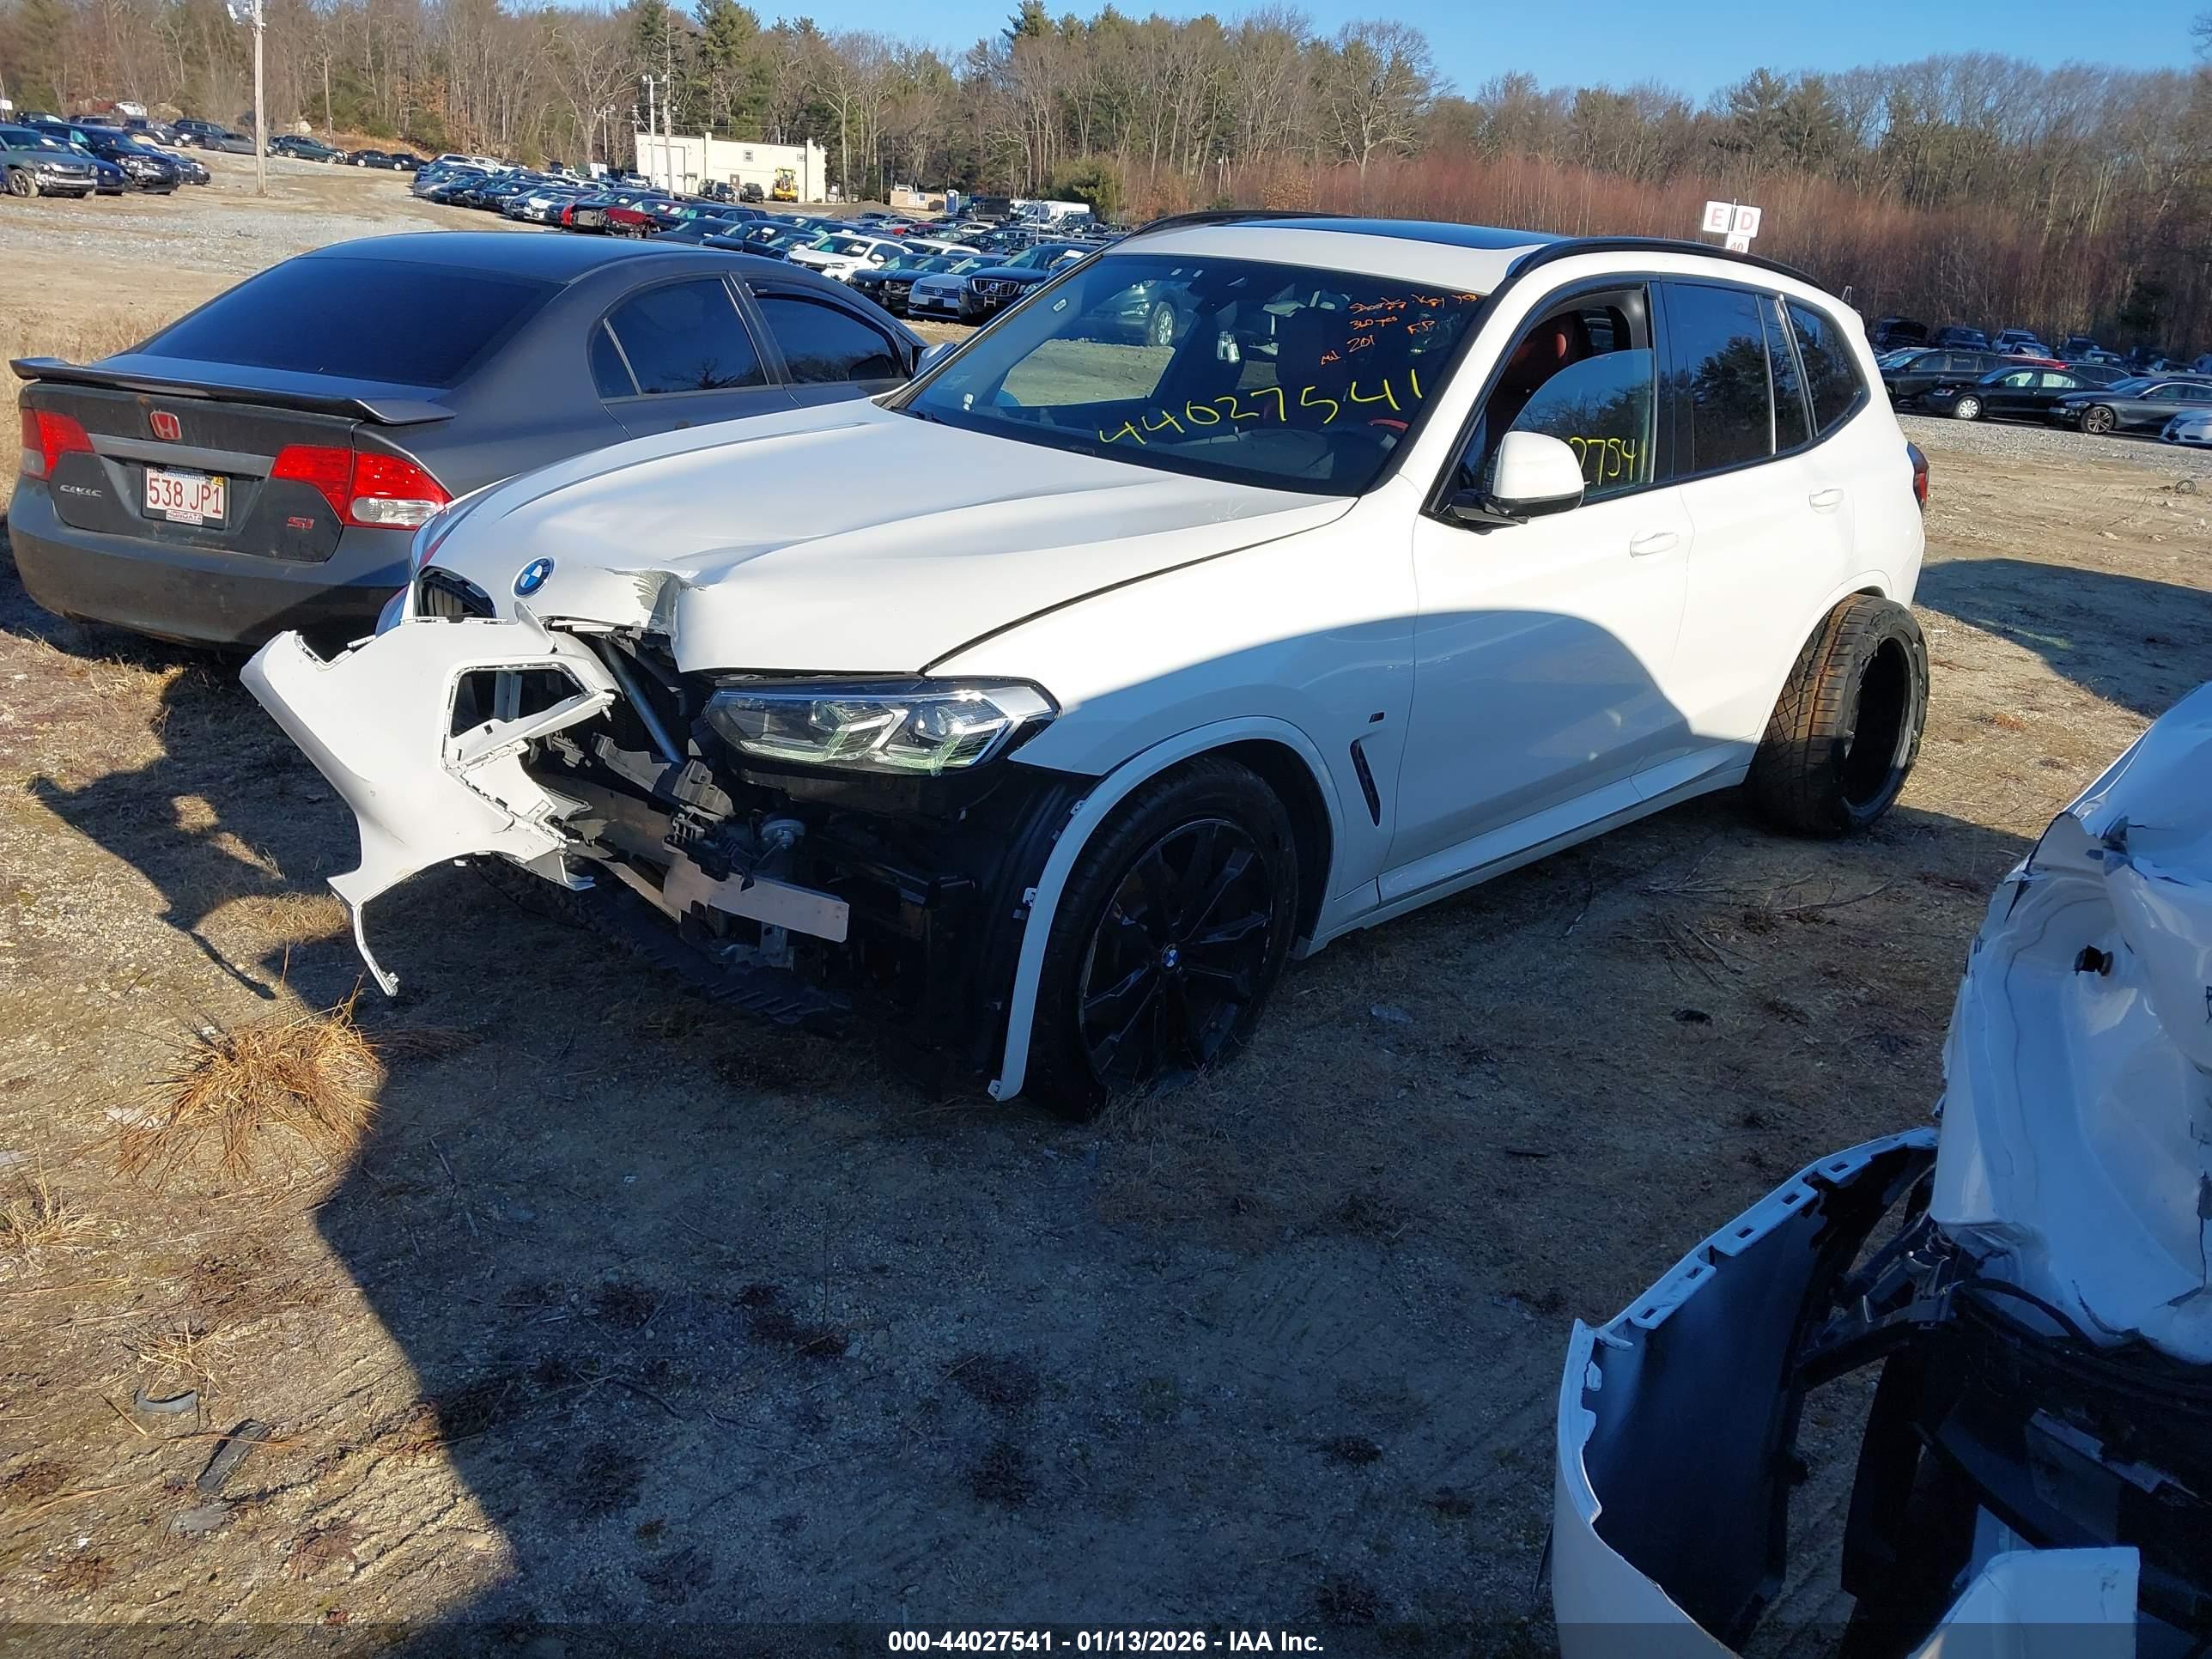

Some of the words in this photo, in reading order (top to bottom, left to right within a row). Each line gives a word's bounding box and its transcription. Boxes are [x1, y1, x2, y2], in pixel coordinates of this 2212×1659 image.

[1711, 208, 1724, 227] E
[1740, 211, 1754, 230] D
[1099, 368, 1422, 445] 44027541
[149, 477, 183, 507] 538
[190, 483, 222, 514] JP1
